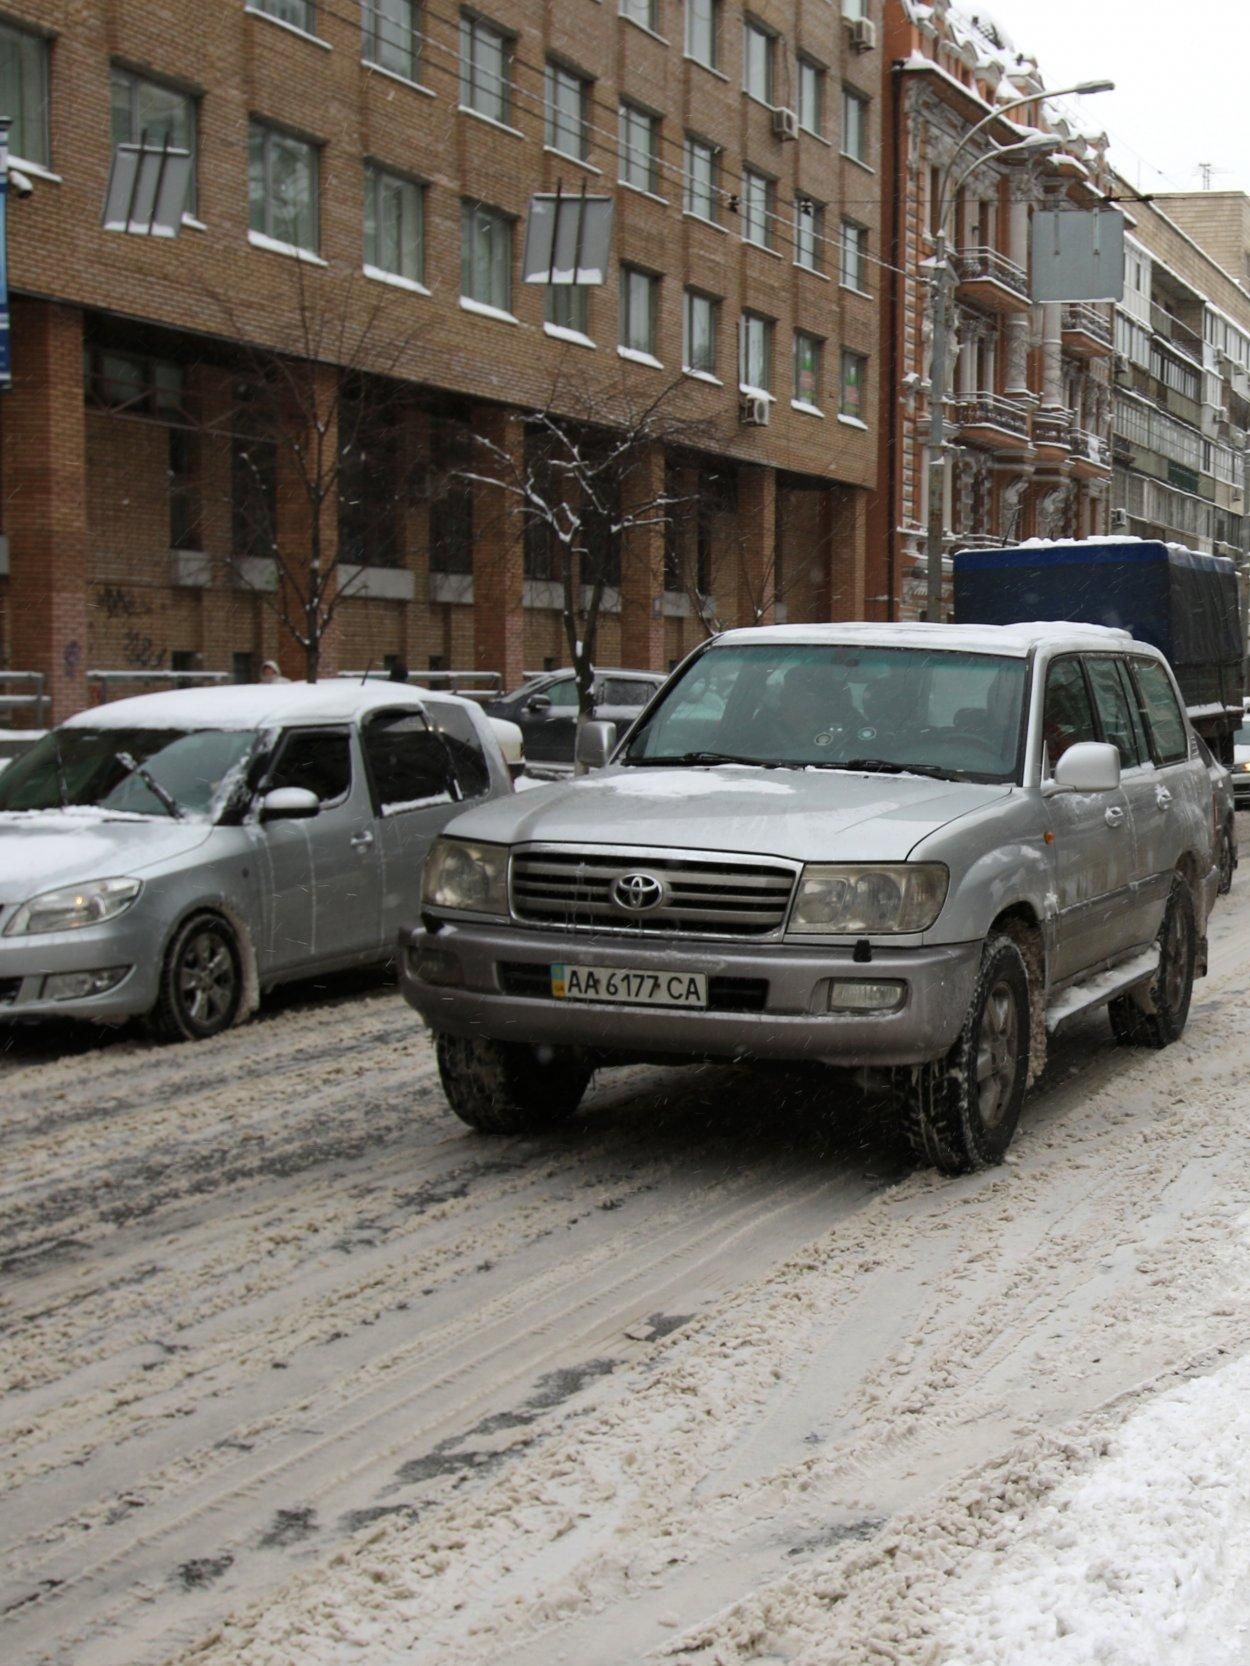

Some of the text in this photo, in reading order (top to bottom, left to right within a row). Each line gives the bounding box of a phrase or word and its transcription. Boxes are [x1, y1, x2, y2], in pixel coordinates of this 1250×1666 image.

[567, 970, 701, 1001] AA 6177 CA
